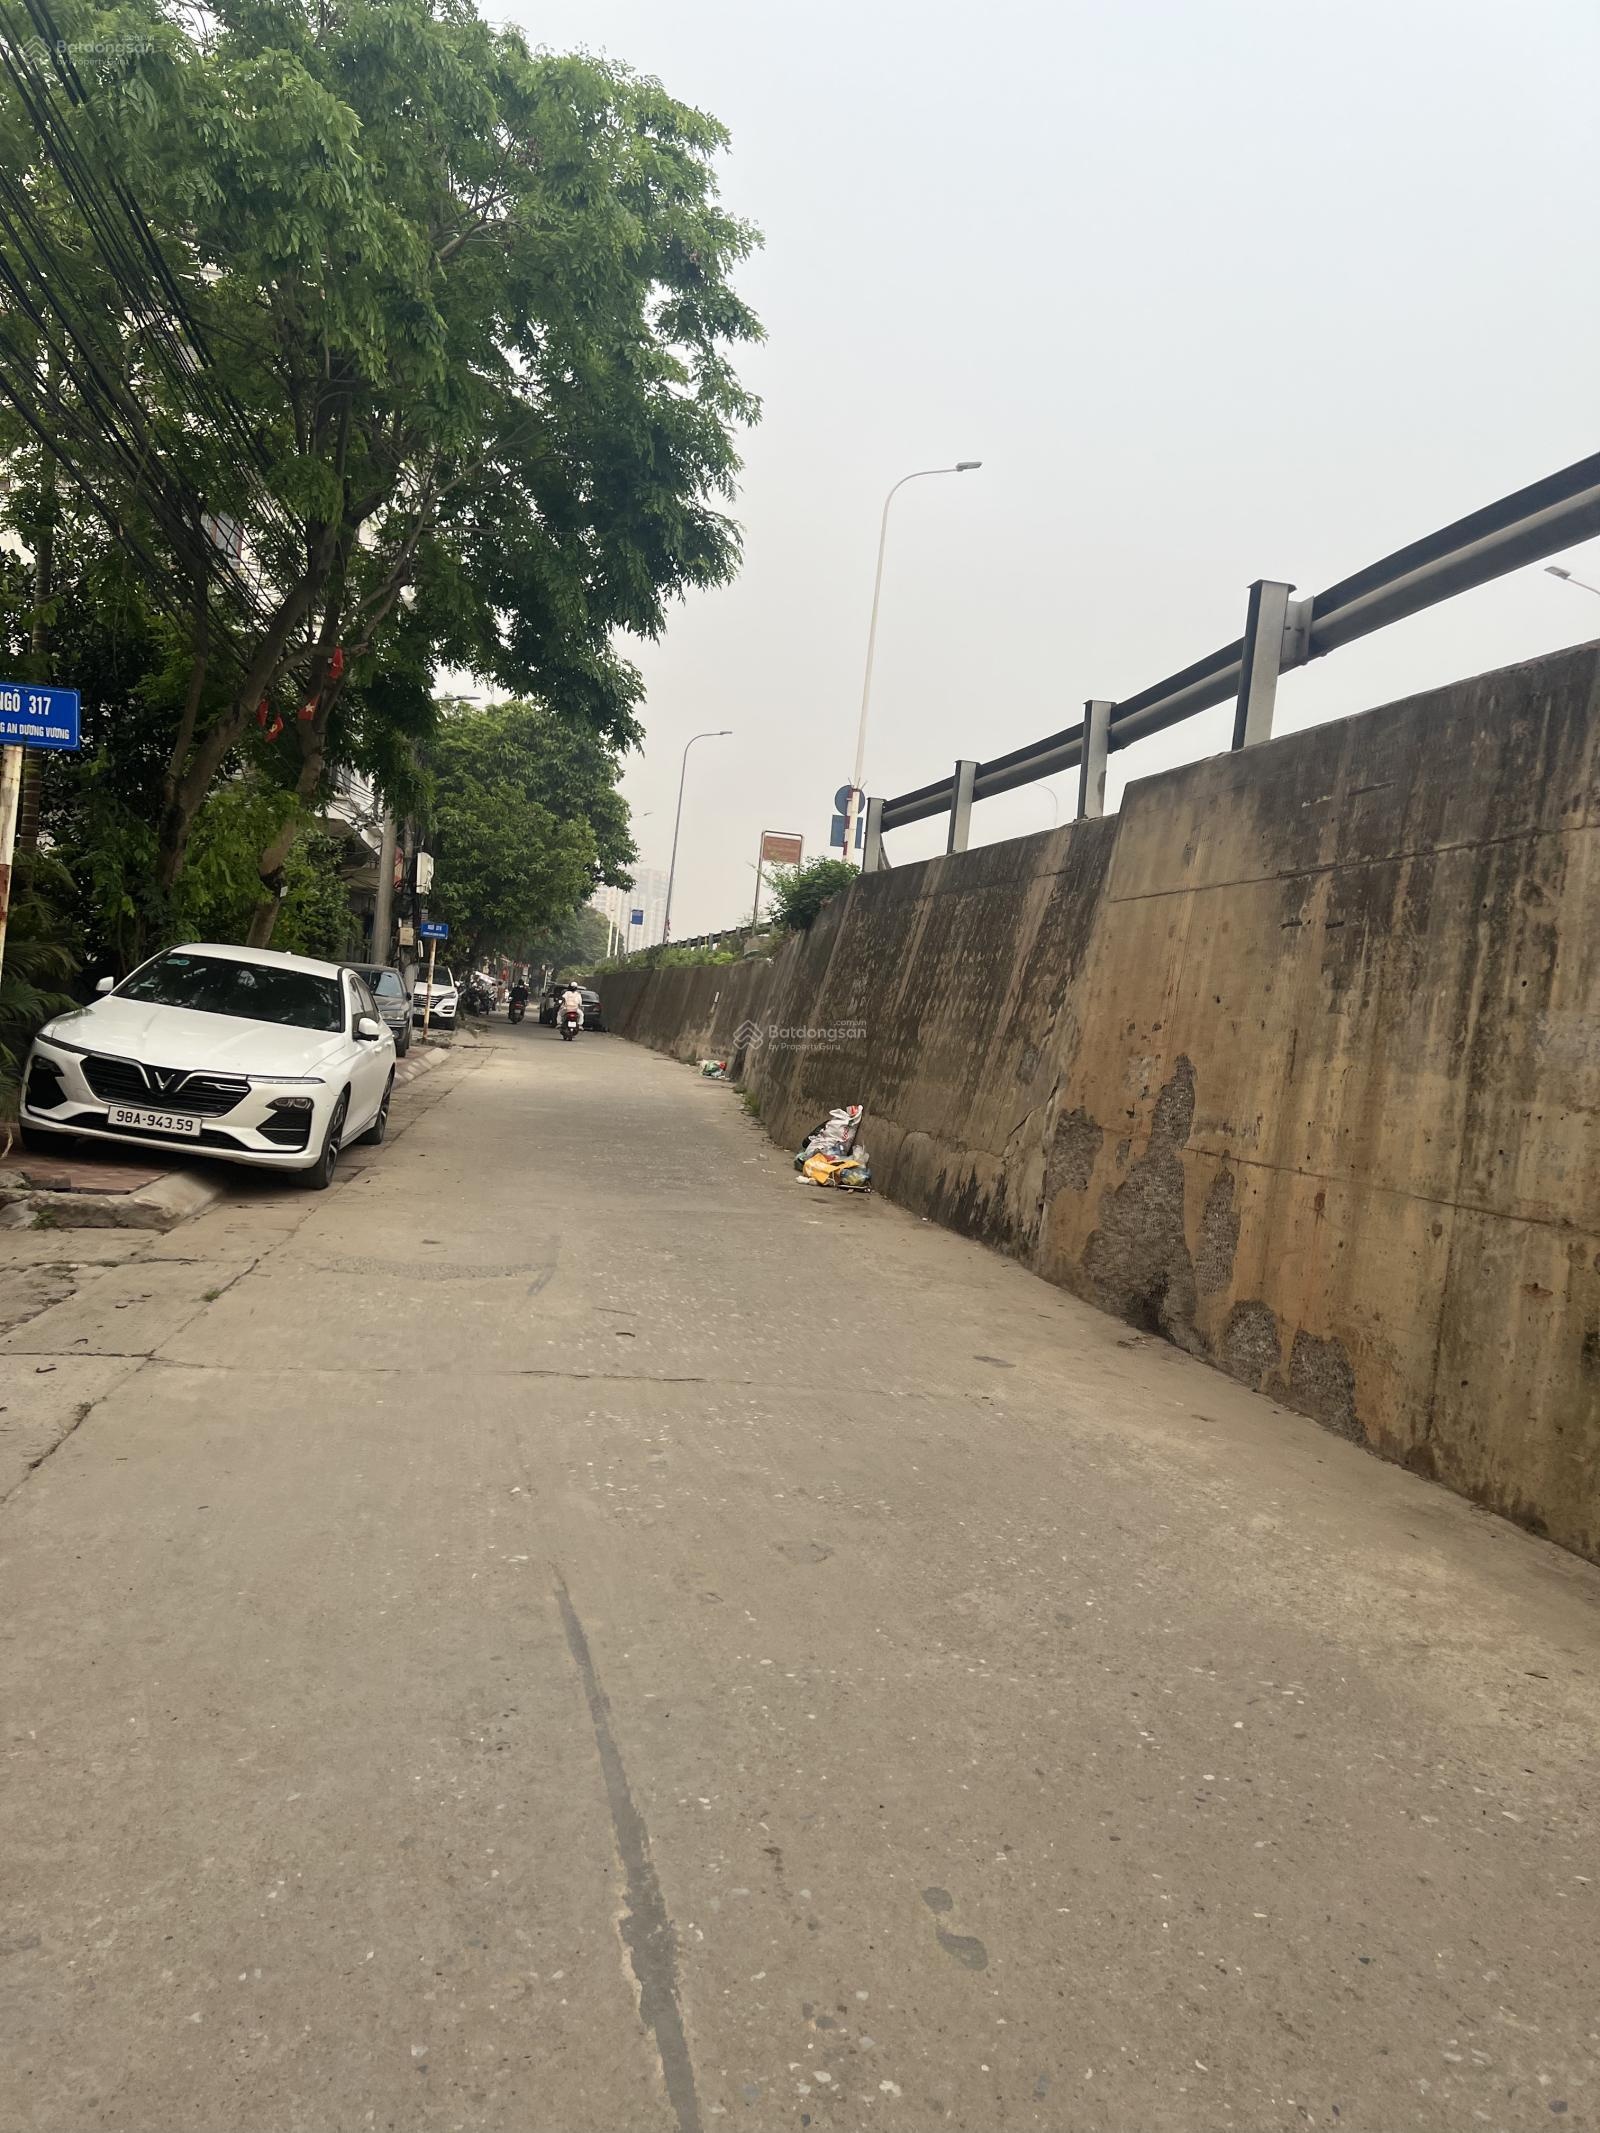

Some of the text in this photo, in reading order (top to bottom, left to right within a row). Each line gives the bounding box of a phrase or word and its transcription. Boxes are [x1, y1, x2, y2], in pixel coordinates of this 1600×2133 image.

[29, 695, 51, 715] 317
[7, 723, 17, 733] AN
[116, 1110, 193, 1132] 98A-943.59
